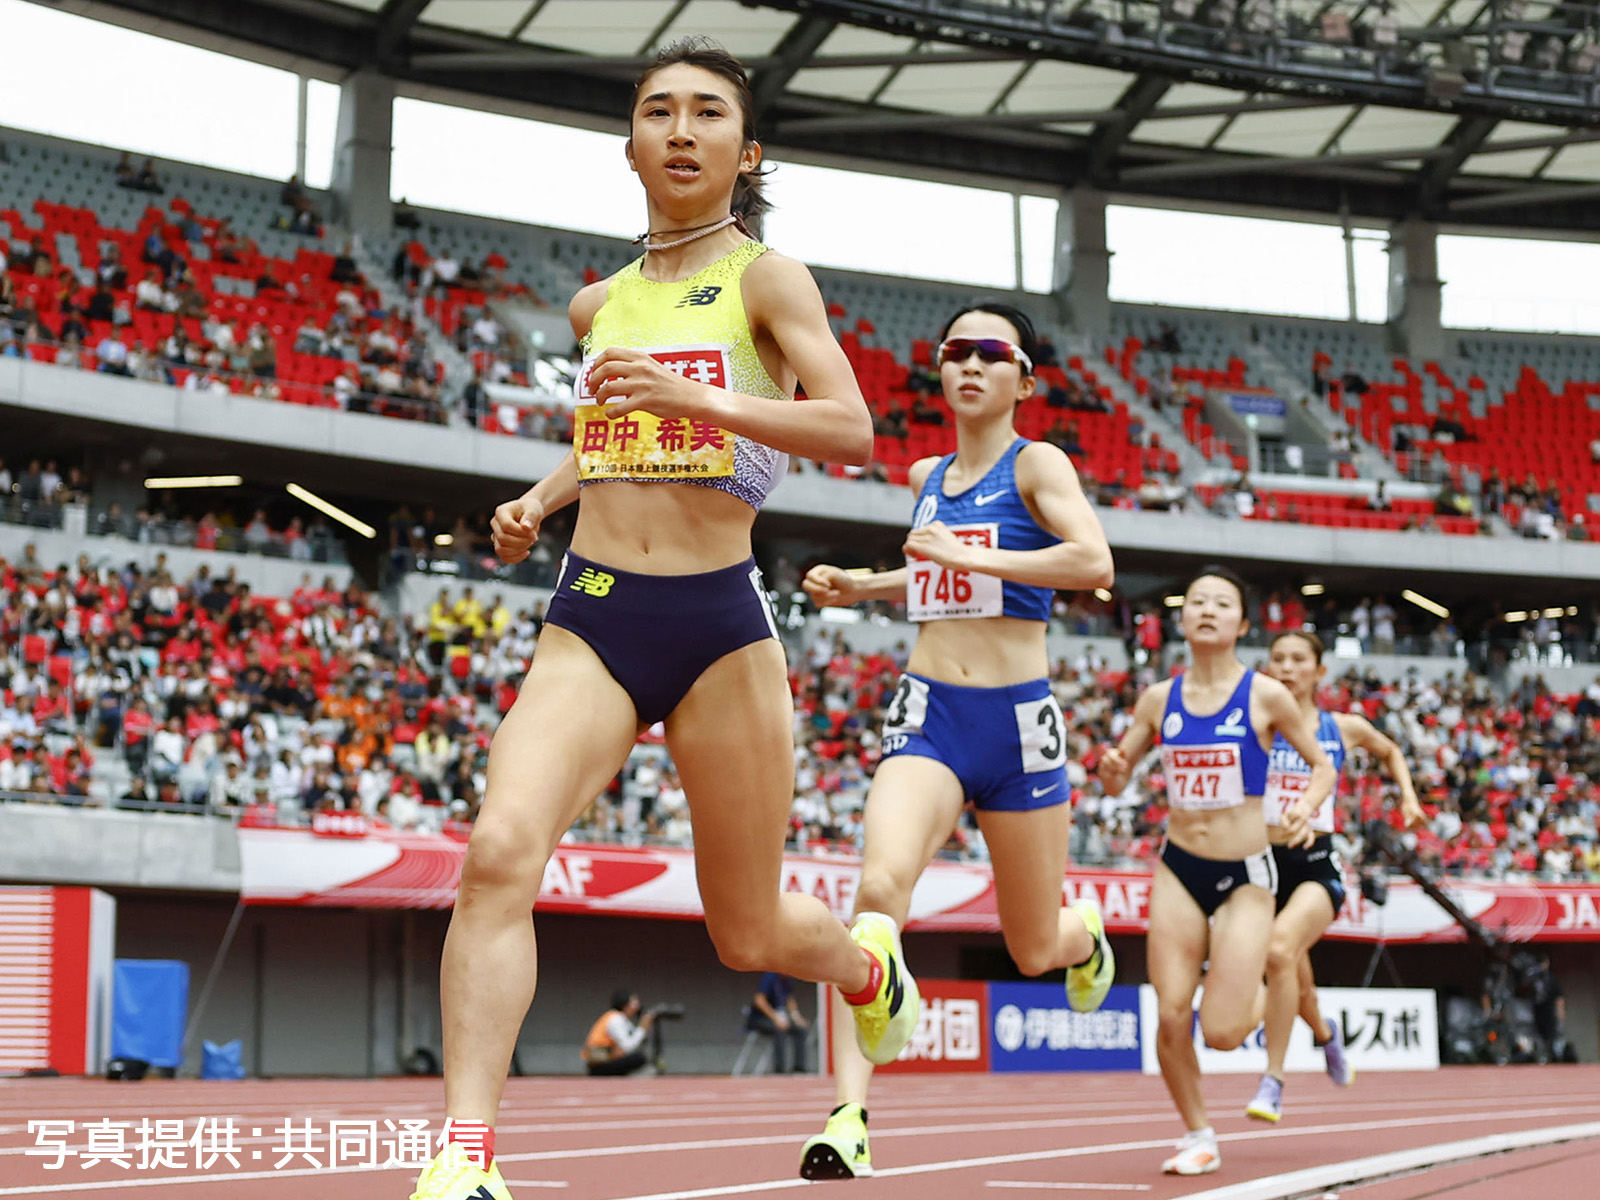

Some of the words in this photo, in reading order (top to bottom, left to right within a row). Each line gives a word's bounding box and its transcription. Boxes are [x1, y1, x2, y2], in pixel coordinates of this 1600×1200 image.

[582, 416, 639, 453] 田中
[915, 570, 973, 606] 746
[1037, 704, 1060, 760] 3
[1175, 774, 1220, 798] 747
[1313, 1010, 1420, 1051] レスポ
